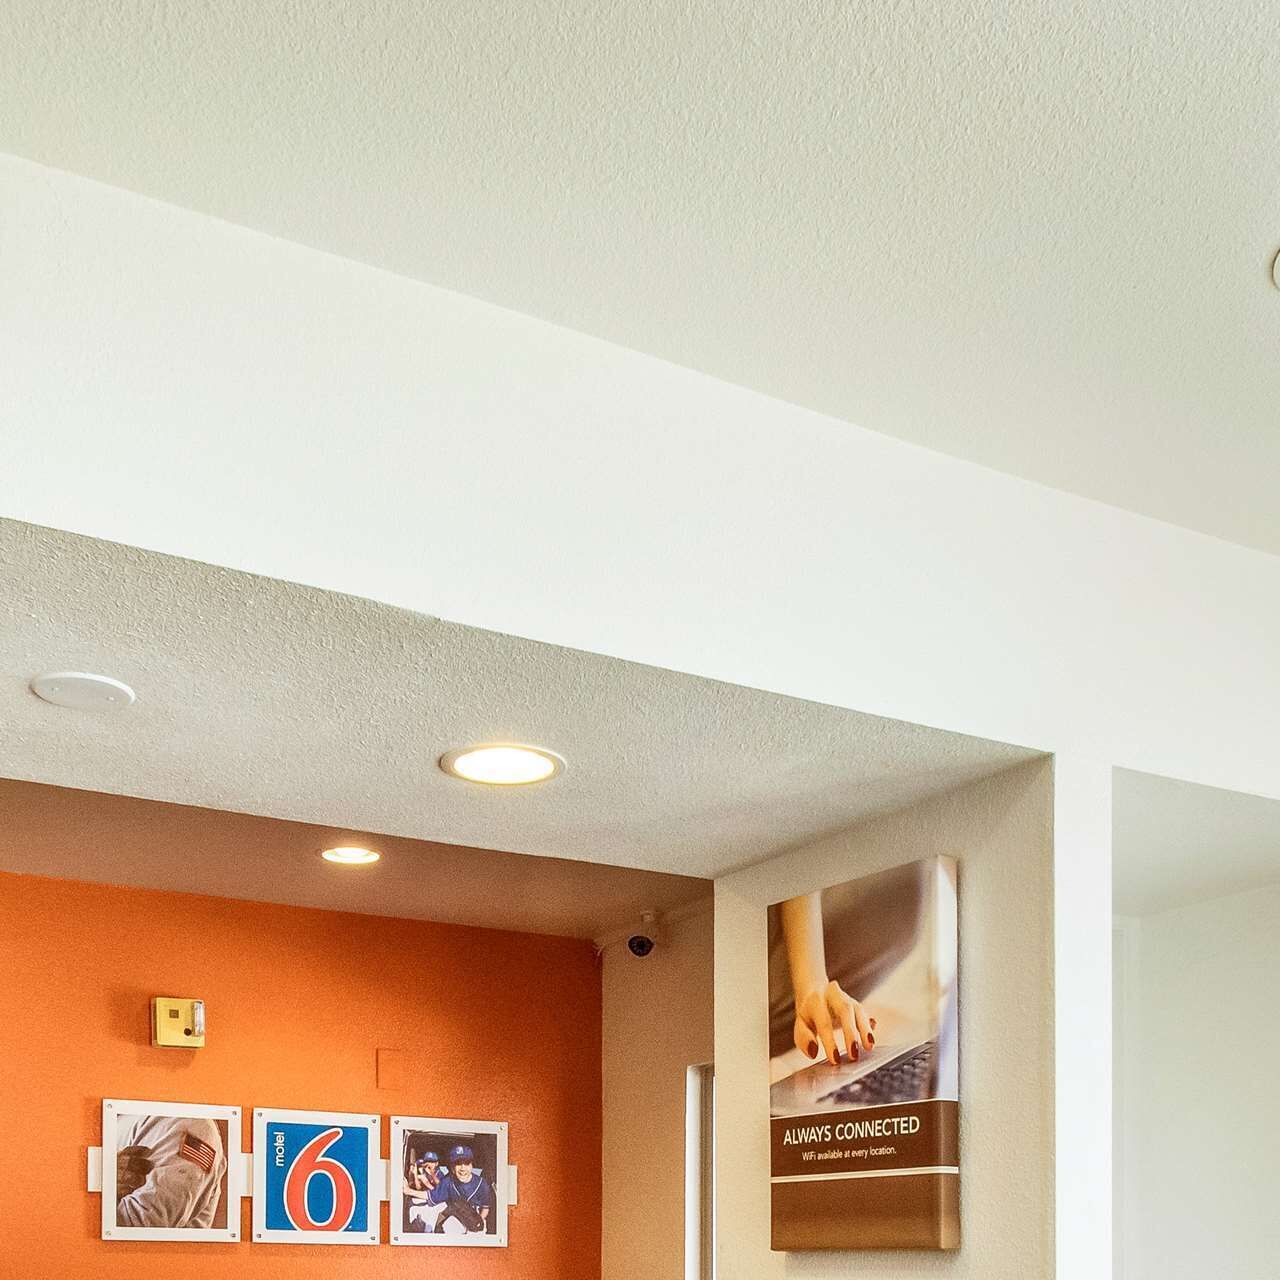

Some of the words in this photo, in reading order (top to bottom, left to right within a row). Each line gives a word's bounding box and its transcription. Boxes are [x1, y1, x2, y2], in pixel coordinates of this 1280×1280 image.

[783, 1125, 831, 1146] ALWAYS
[835, 1116, 920, 1140] CONNECTED
[274, 1131, 285, 1167] motel
[802, 1151, 816, 1161] WiFi
[817, 1149, 842, 1160] available
[844, 1149, 851, 1158] at
[851, 1147, 868, 1159] every
[869, 1145, 897, 1156] location.
[283, 1127, 357, 1232] 6
